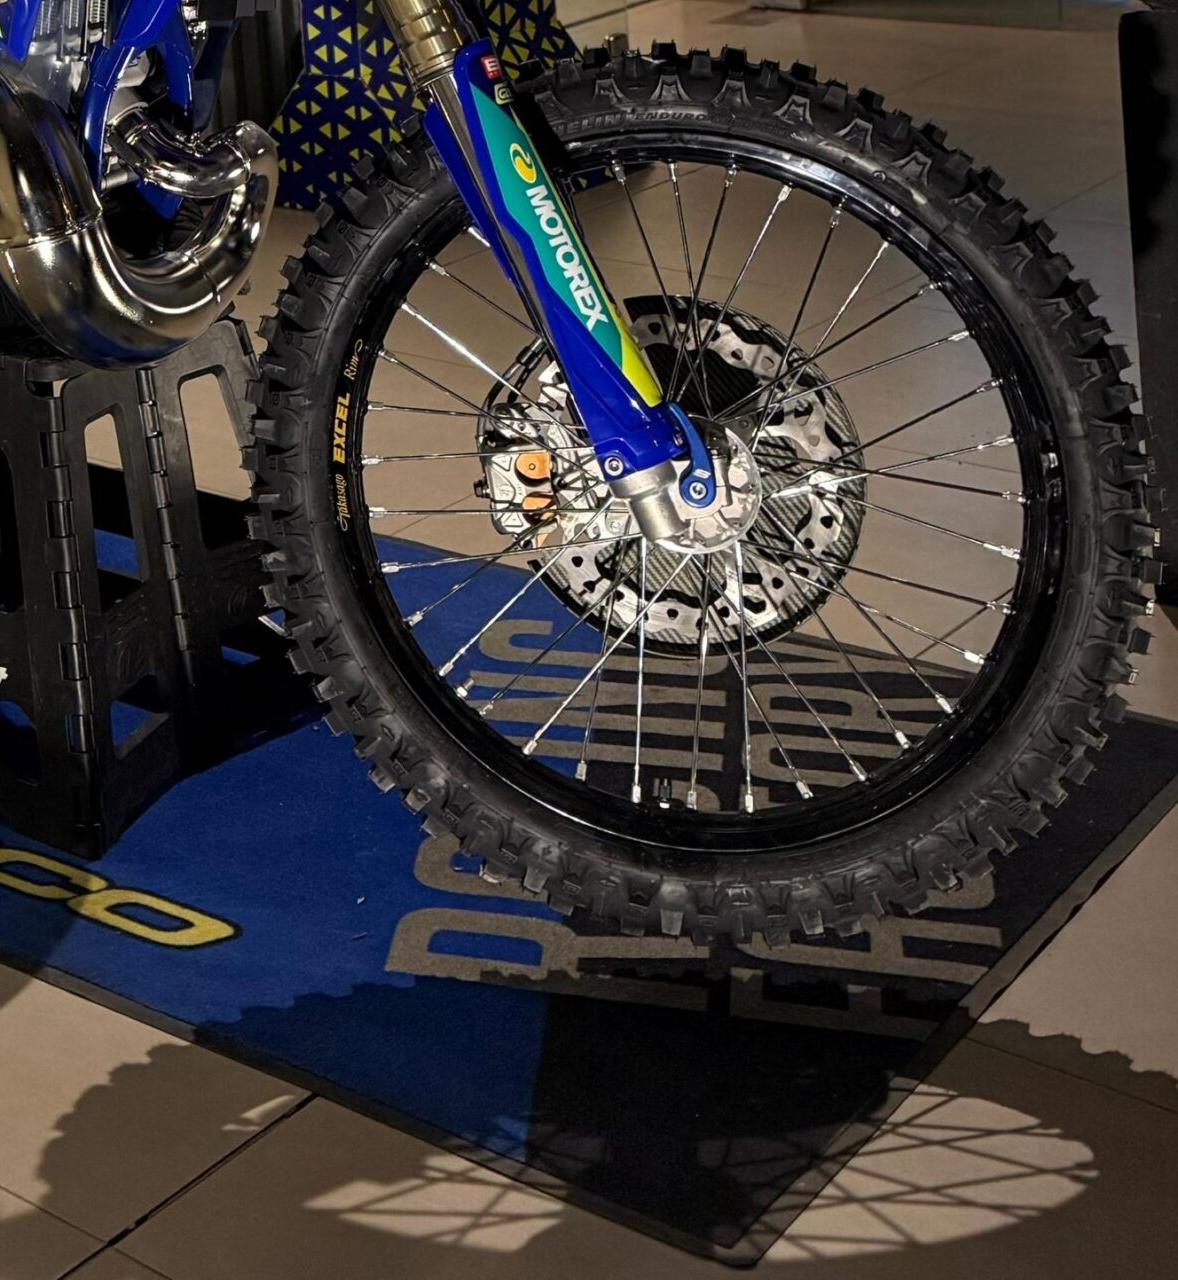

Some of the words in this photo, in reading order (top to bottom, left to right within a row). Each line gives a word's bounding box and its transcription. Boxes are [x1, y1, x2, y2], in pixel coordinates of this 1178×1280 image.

[553, 112, 625, 137] HELIN
[635, 111, 708, 122] ENDURO
[526, 184, 609, 331] MOTOREX
[333, 392, 350, 464] EXCEL
[384, 619, 732, 1012] RING
